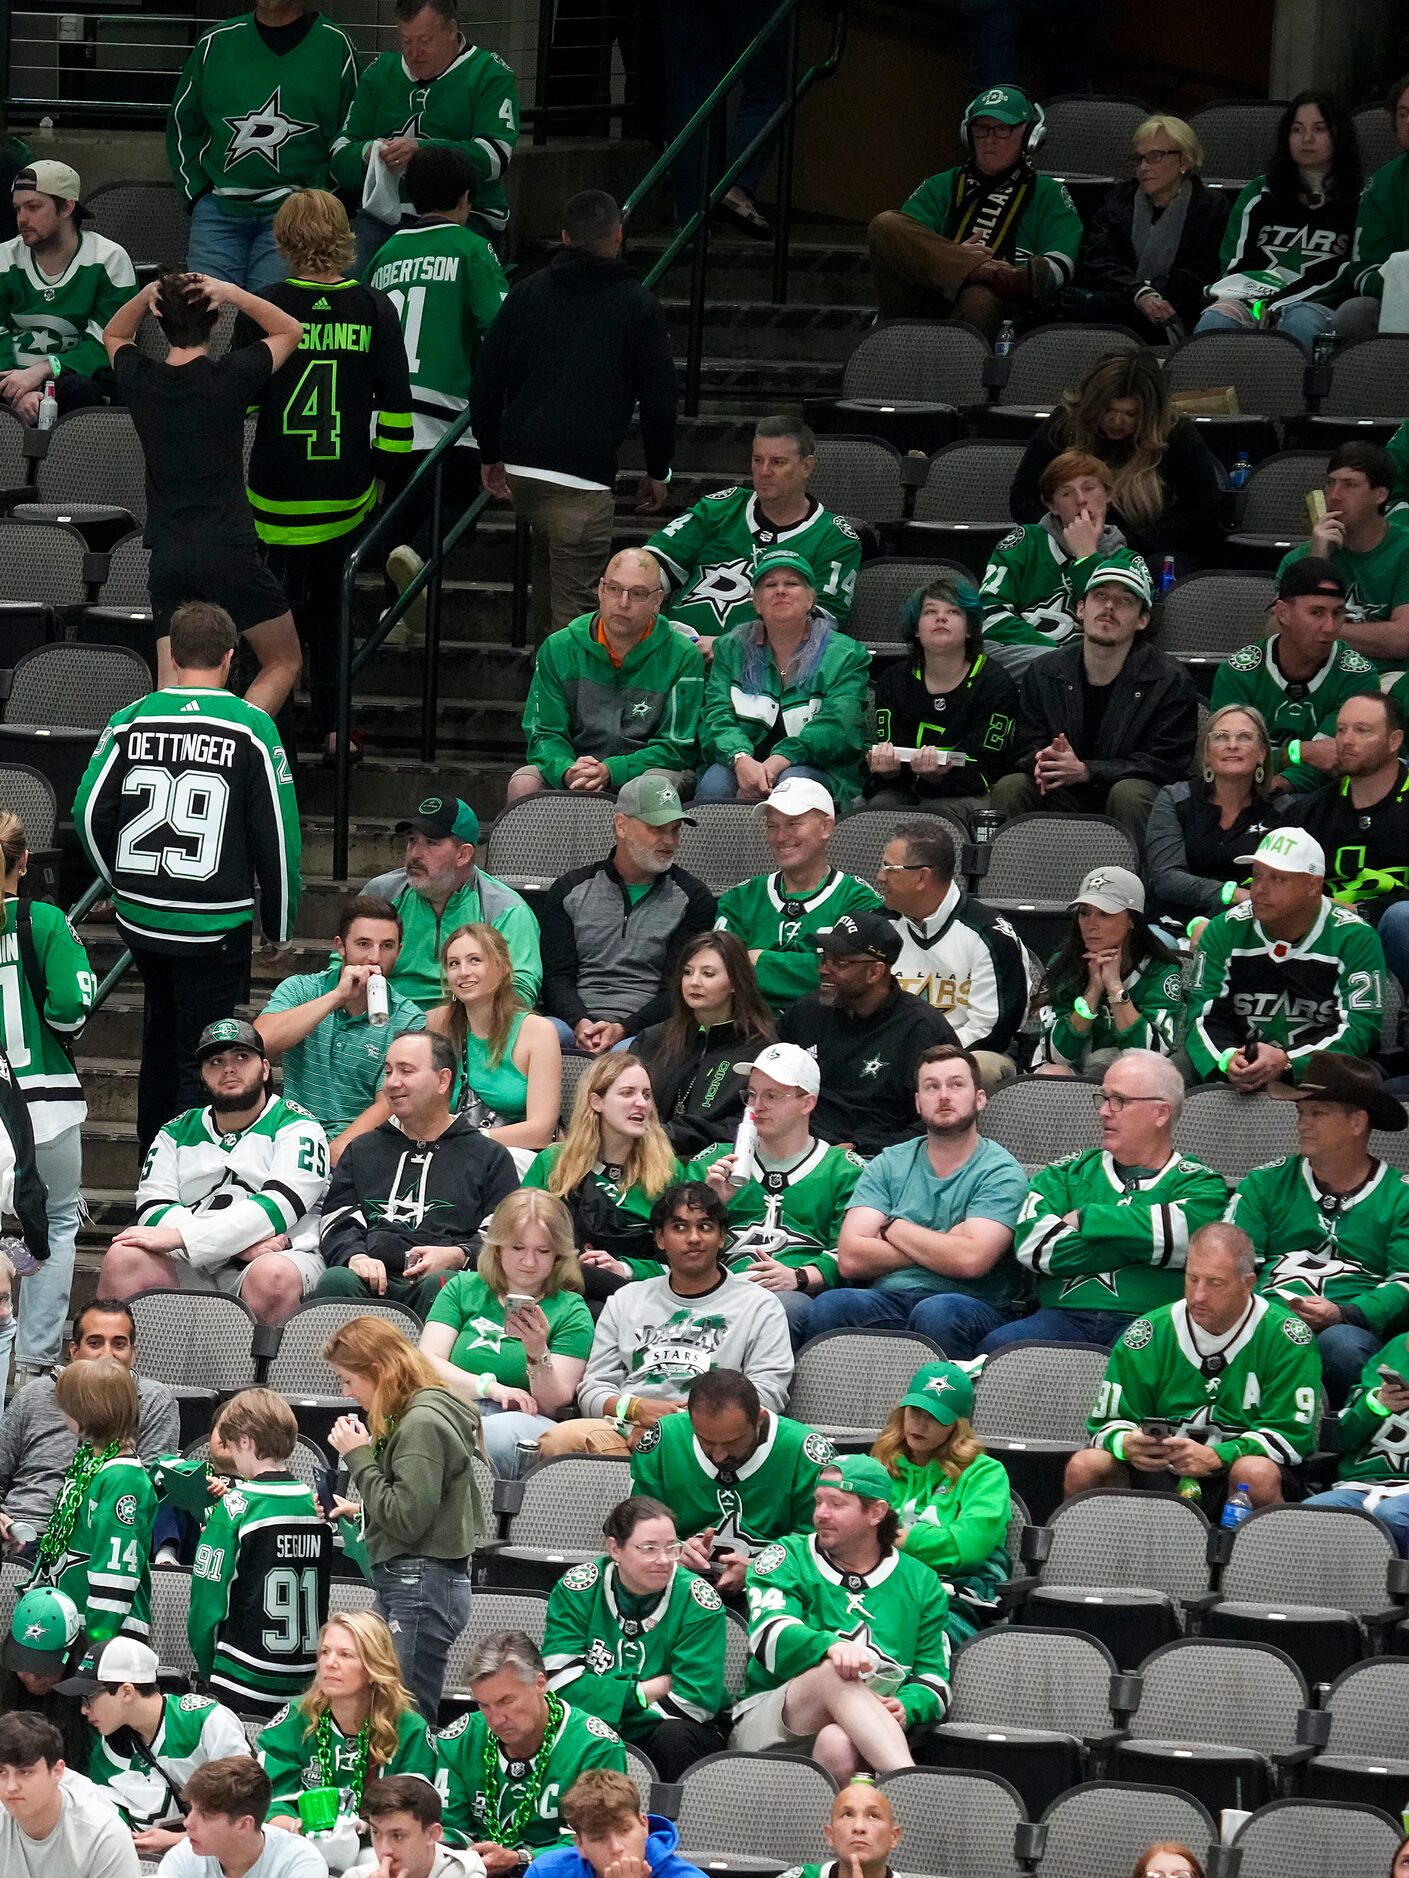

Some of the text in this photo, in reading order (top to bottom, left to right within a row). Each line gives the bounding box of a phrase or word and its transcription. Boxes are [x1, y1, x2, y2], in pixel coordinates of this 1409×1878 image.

[499, 98, 515, 131] 4
[1256, 223, 1352, 257] STARS
[297, 322, 372, 353] SKANEN
[282, 358, 341, 461] 4
[823, 561, 858, 601] 14
[127, 731, 237, 768] OETTINGER
[115, 765, 230, 882] 29
[76, 970, 97, 1007] 91
[894, 970, 972, 980] ALLAS
[898, 976, 973, 1011] TARS
[1348, 969, 1383, 1010] 21
[1232, 993, 1336, 1018] STARS
[701, 1059, 731, 1109] CINCH
[298, 1136, 326, 1178] 25
[635, 1317, 728, 1353] DALLAS
[653, 1350, 699, 1362] STARS
[1091, 1380, 1123, 1419] 91
[1242, 1371, 1261, 1410] A
[1294, 1386, 1315, 1424] 9
[106, 1536, 138, 1573] 14
[193, 1544, 225, 1582] 91
[276, 1534, 321, 1558] SEGUIN
[262, 1566, 321, 1655] 91
[539, 1783, 560, 1819] C
